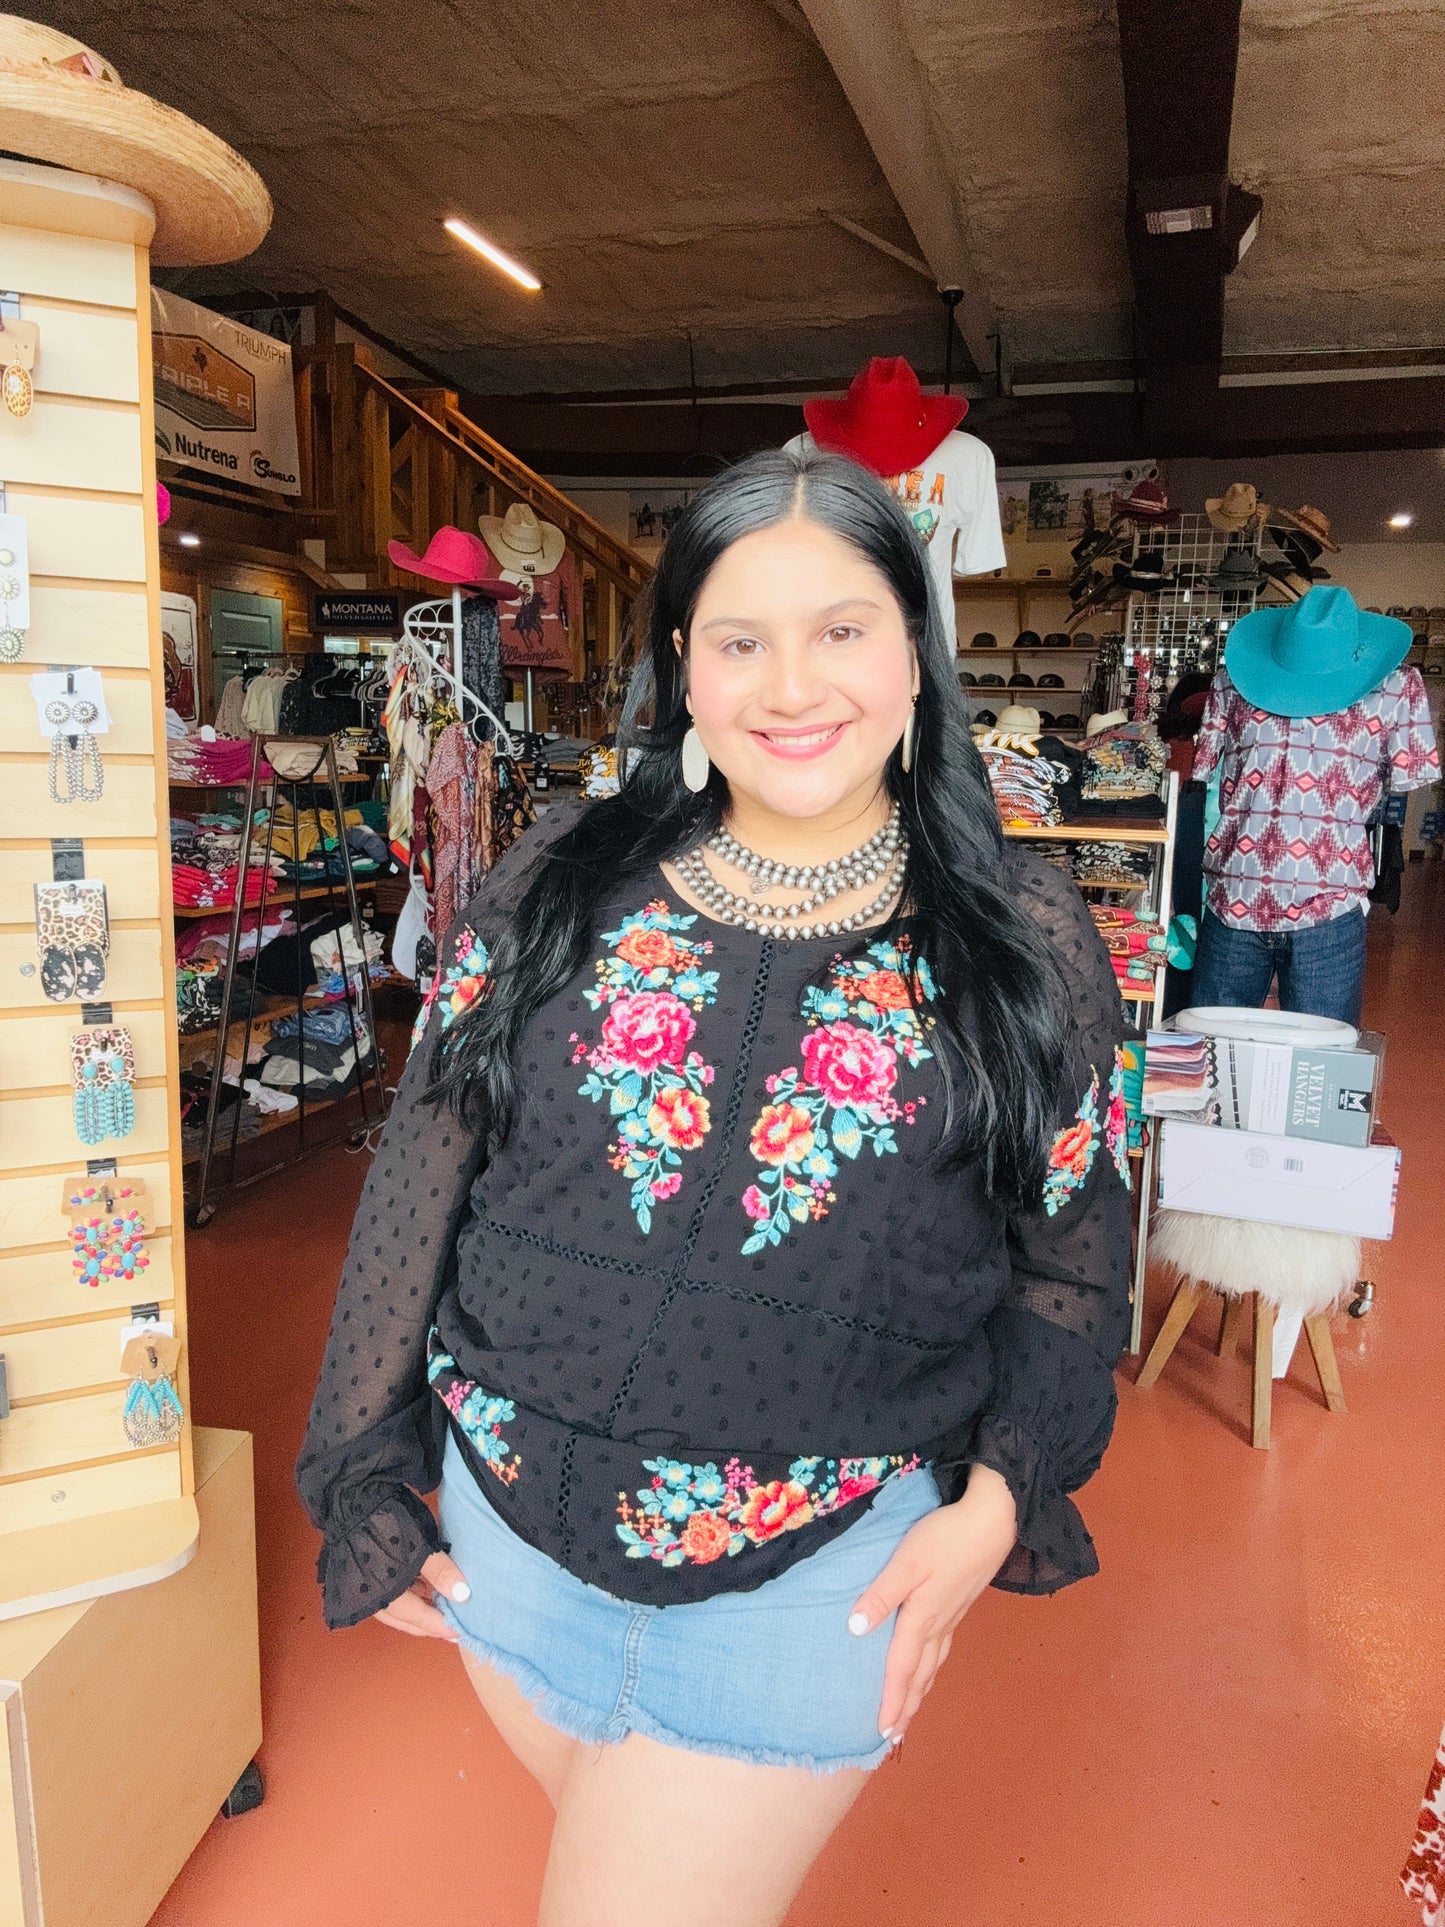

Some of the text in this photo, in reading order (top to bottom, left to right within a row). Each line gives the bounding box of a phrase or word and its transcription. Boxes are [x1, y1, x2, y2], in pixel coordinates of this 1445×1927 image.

[235, 331, 287, 364] TRIUMPH
[175, 433, 238, 470] Nutrena
[332, 604, 393, 614] MONTANA
[1292, 1061, 1310, 1126] HANGERS
[1305, 1064, 1325, 1128] VELVET
